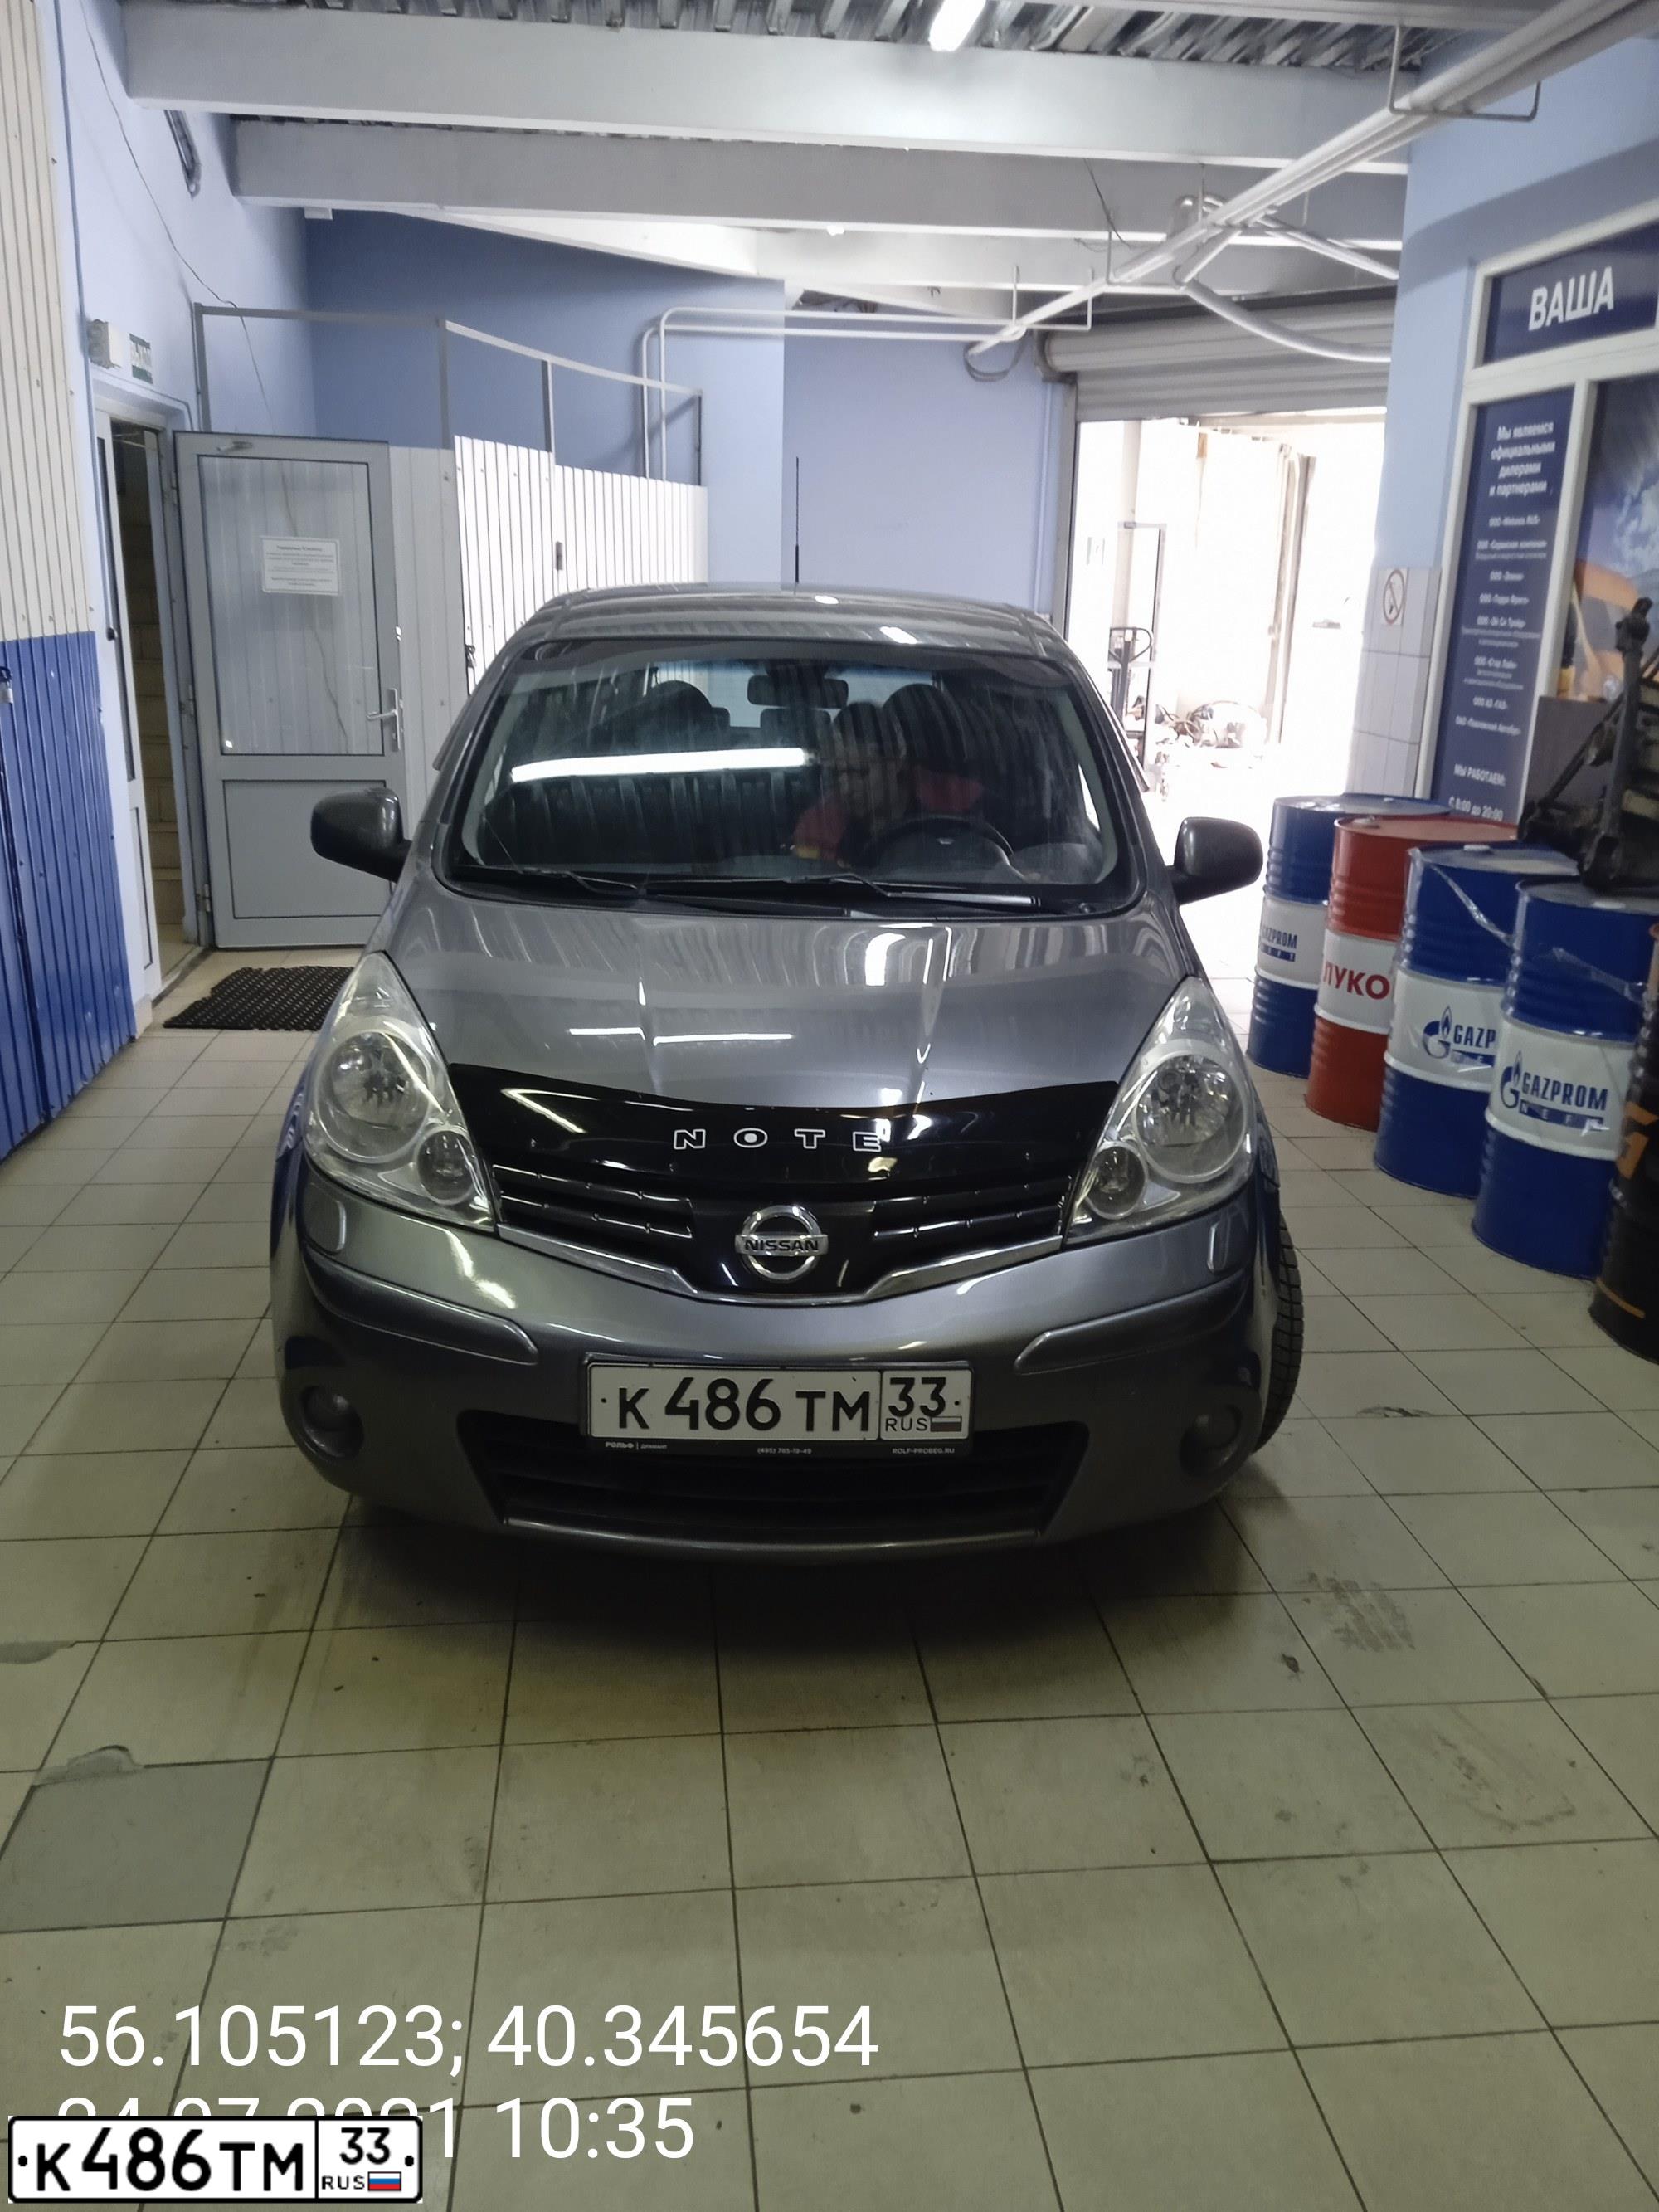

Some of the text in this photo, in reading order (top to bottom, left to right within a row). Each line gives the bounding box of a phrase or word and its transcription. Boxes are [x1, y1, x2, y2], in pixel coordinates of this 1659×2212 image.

[1528, 265, 1614, 331] ВАША
[1496, 425, 1511, 441] Мы
[1491, 441, 1555, 461] официальными
[1498, 461, 1542, 479] дилерами
[1261, 925, 1297, 949] AZPROM
[1522, 1071, 1608, 1111] GAZPROM
[673, 1128, 882, 1152] NOTE
[744, 1238, 819, 1252] NISSAN
[888, 1377, 946, 1417] 33
[885, 1418, 927, 1432] RUS
